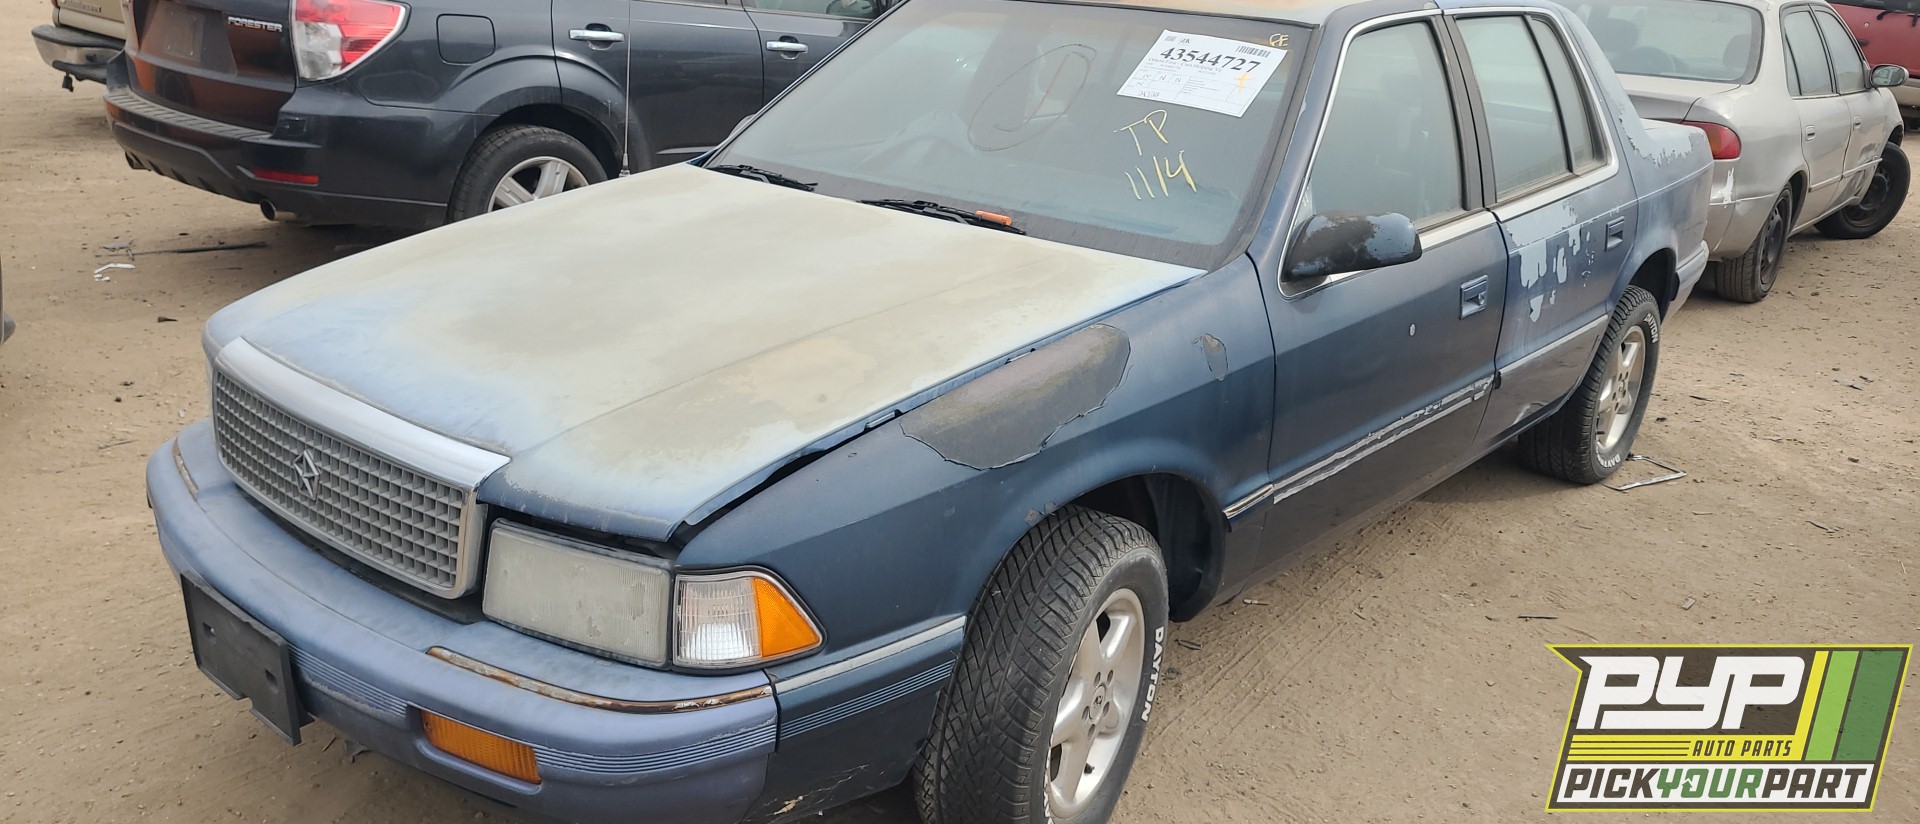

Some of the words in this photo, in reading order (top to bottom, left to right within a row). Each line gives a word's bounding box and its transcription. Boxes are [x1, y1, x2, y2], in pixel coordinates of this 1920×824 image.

[228, 16, 282, 32] FORESTER
[1160, 46, 1261, 73] 43544727
[1113, 110, 1168, 156] TP
[1643, 313, 1659, 343] DAYTON
[1141, 626, 1164, 722] DAYTON
